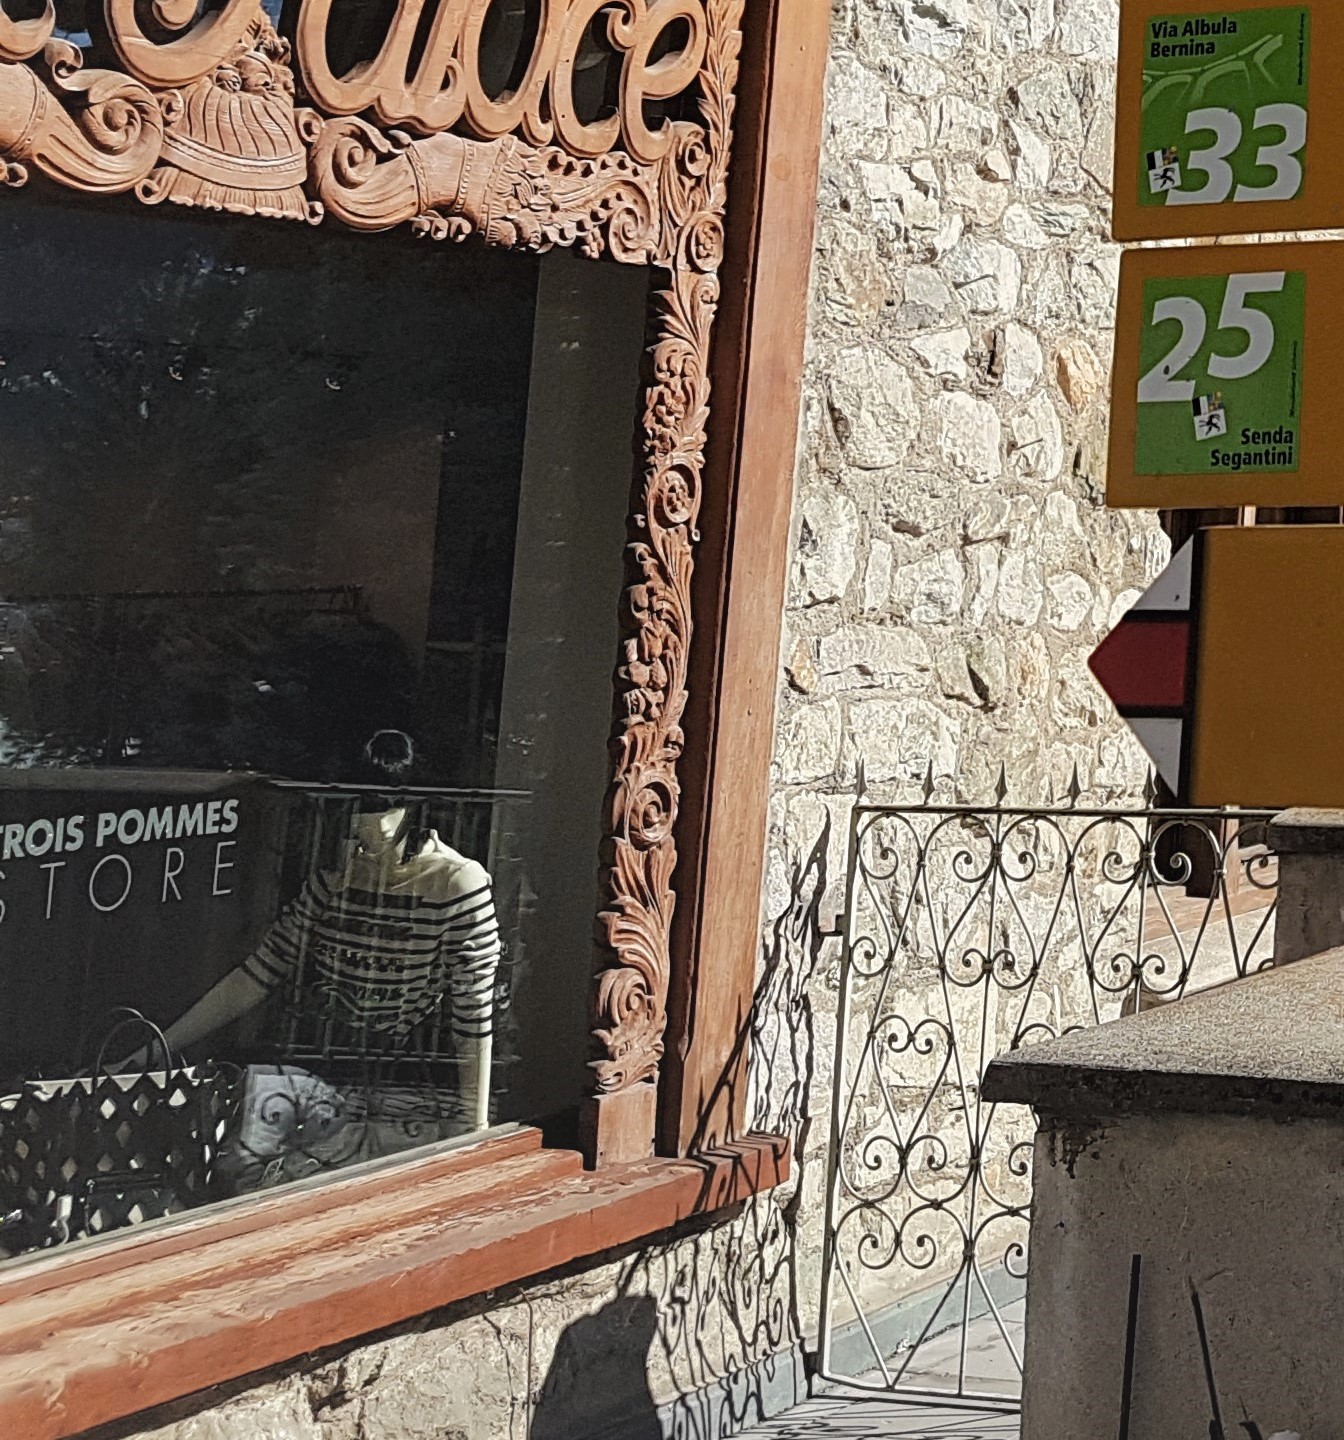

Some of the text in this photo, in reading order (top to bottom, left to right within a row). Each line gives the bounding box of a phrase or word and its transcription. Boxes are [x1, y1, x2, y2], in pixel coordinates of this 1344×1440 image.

[1151, 17, 1237, 39] Via Albula
[1150, 40, 1216, 58] Bernina
[1165, 103, 1307, 205] 33
[1137, 271, 1286, 403] 25
[1241, 425, 1293, 445] Senda
[1210, 446, 1293, 470] Segantini
[95, 798, 240, 848] POMMES
[0, 840, 237, 925] TORE
